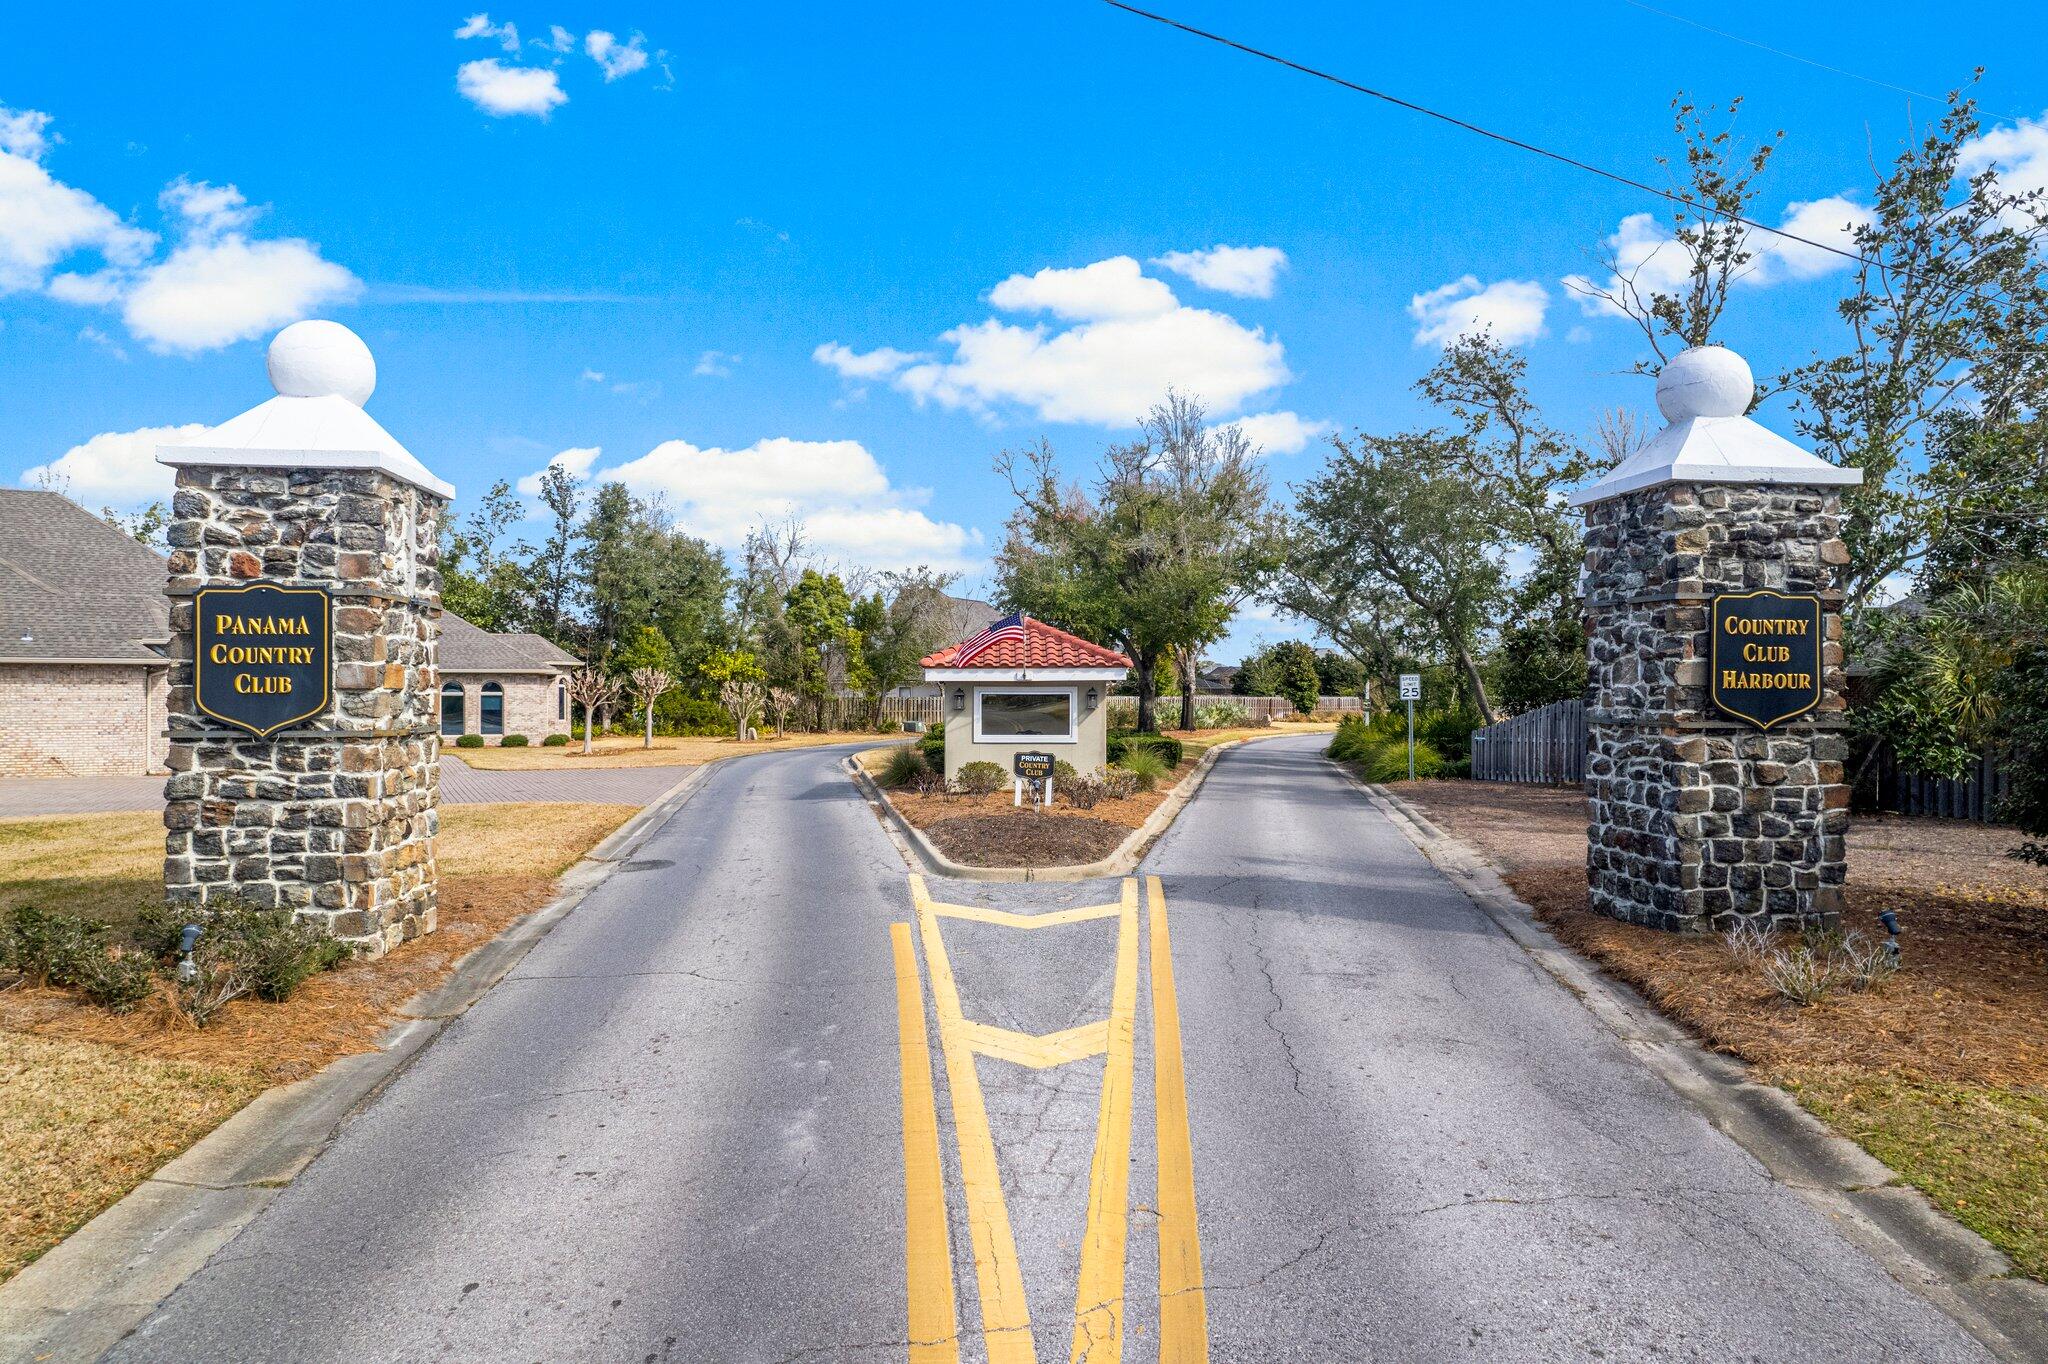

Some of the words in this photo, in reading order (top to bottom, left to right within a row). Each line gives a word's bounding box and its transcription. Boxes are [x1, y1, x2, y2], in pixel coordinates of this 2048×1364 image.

[215, 614, 310, 635] PANAMA
[1724, 615, 1810, 636] COUNTRY
[209, 643, 315, 664] COUNTRY
[1743, 643, 1790, 662] CLUB
[233, 673, 293, 694] CLUB
[1722, 670, 1811, 690] HARBOUR
[1402, 687, 1419, 698] 25
[1019, 761, 1050, 770] COUNTRY
[1025, 768, 1043, 776] CLUB
